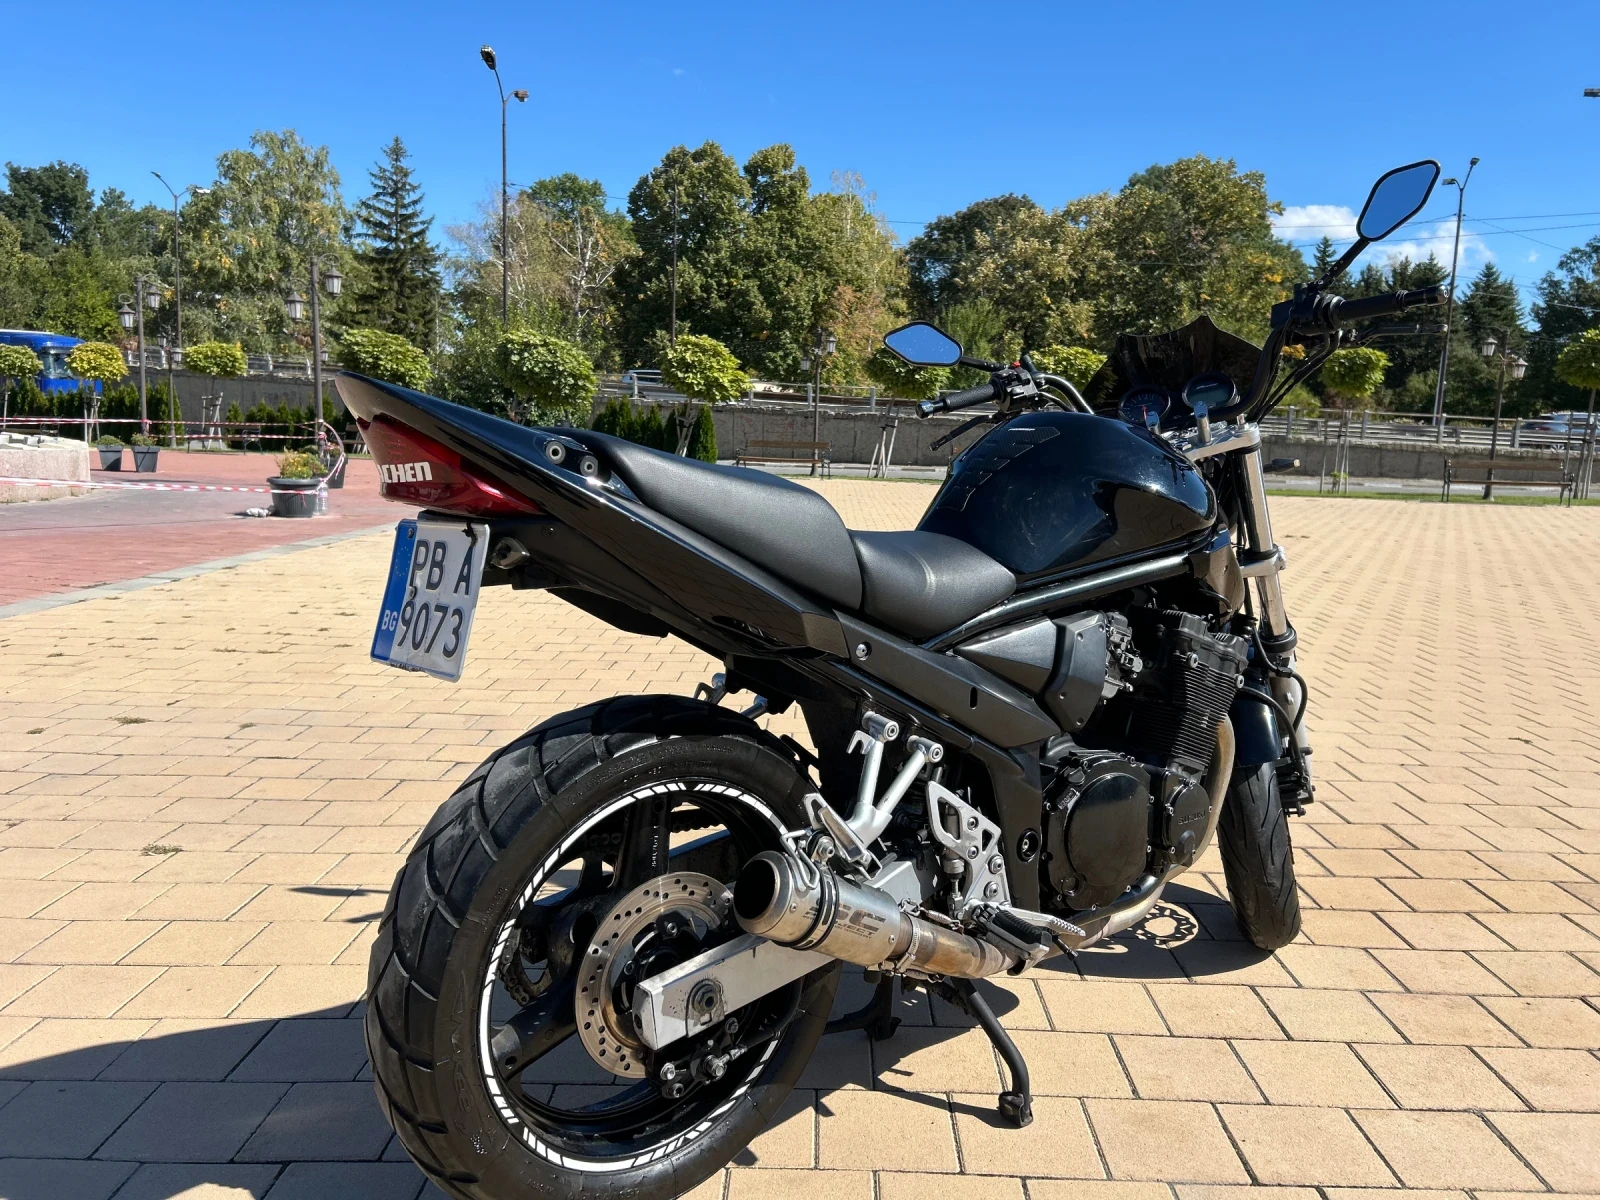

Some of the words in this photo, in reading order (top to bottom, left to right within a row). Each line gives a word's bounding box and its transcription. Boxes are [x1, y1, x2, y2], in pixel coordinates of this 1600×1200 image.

[377, 461, 433, 483] CHEN
[409, 539, 448, 591] PB
[453, 546, 474, 596] A
[381, 609, 398, 632] BG
[397, 601, 463, 659] 9073
